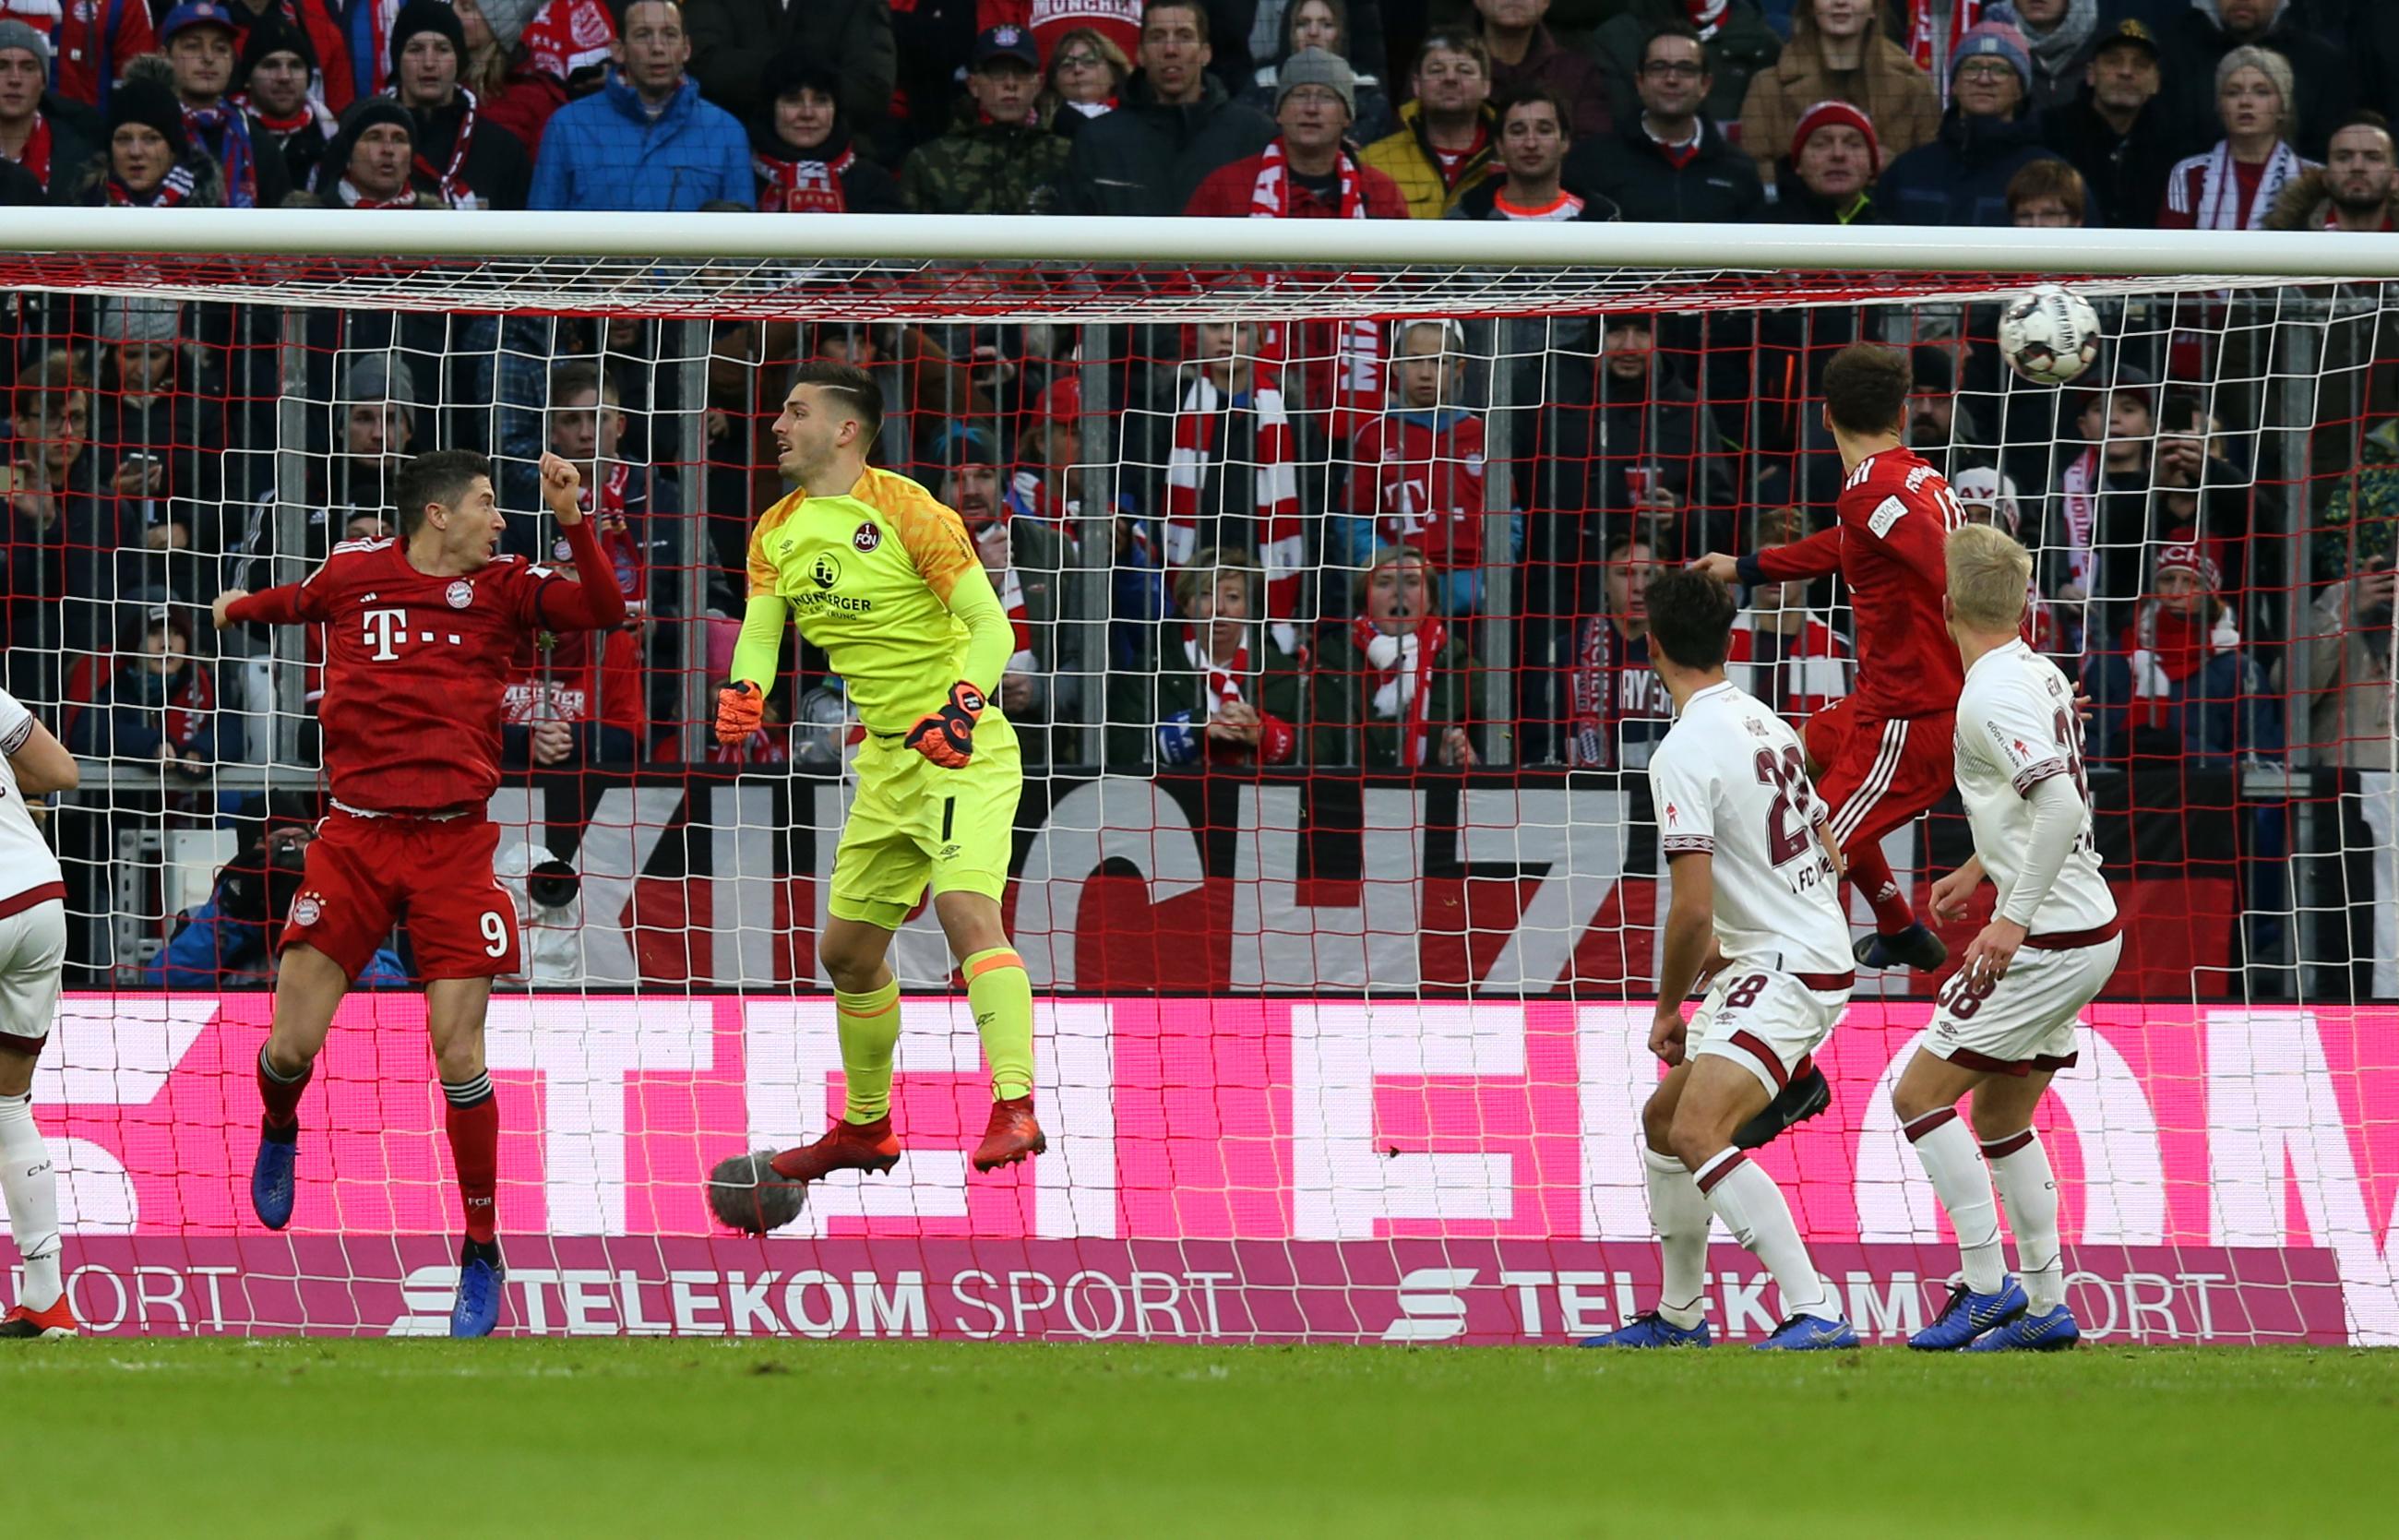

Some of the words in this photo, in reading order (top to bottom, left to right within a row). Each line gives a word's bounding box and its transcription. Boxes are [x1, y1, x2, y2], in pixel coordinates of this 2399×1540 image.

[1987, 720, 2022, 770] GODELMANN
[942, 795, 956, 842] 1
[481, 911, 508, 958] 9
[1718, 973, 1769, 1011] 8
[1938, 970, 1997, 1021] 38
[0, 1265, 238, 1332] ORT
[503, 1268, 929, 1338] TELEKOM
[951, 1269, 1234, 1339] SPORT
[1500, 1271, 1923, 1339] TELKM
[1943, 1271, 2226, 1341] ORT
